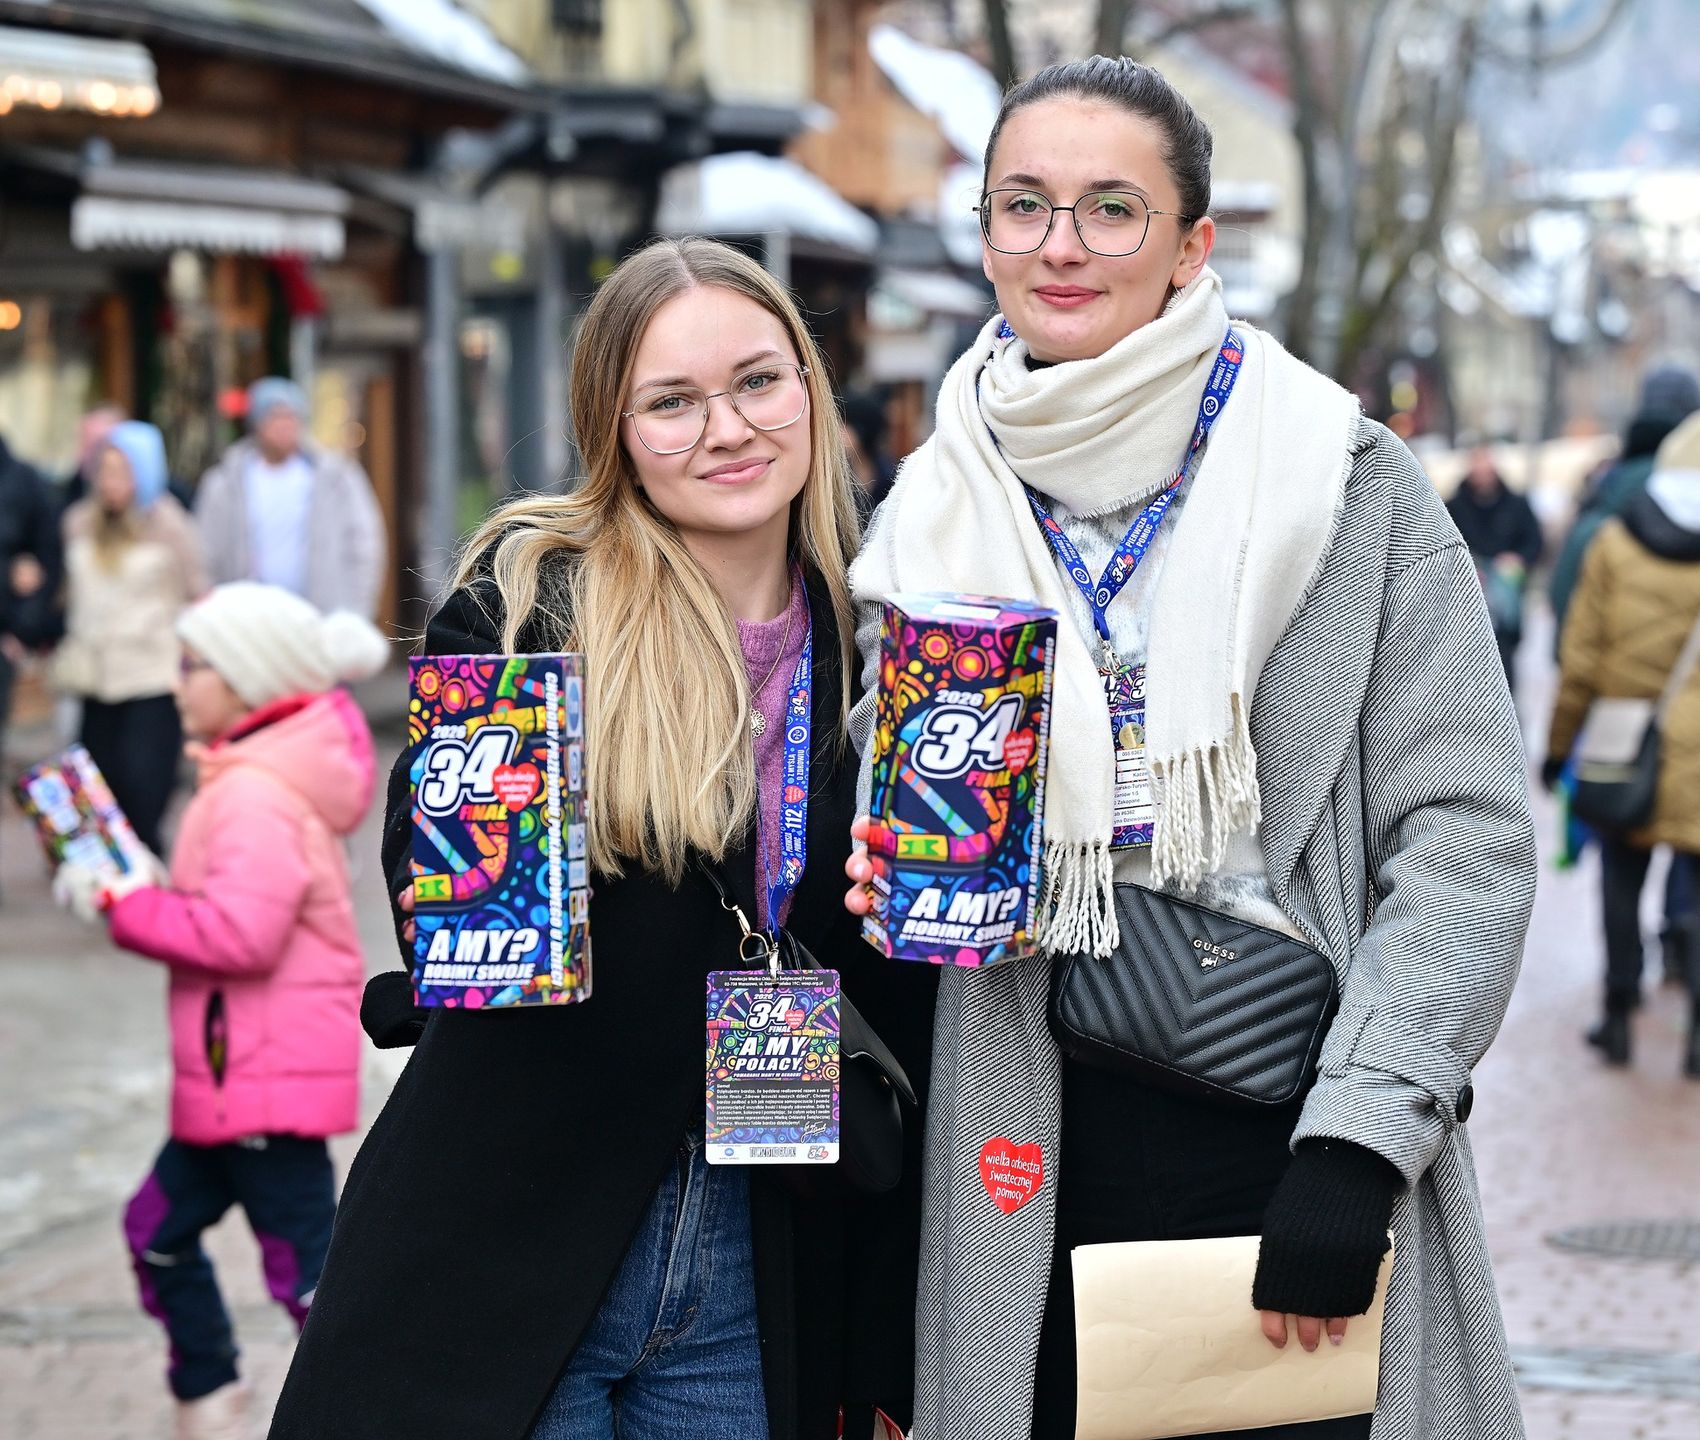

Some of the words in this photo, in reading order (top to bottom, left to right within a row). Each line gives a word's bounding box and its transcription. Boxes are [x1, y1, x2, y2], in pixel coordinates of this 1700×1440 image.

[1148, 494, 1171, 513] 112
[1125, 517, 1148, 548] PIERWSZA
[1136, 524, 1153, 548] POMOC
[1112, 554, 1129, 583] 34
[791, 696, 806, 716] 34
[934, 689, 985, 707] 2026
[431, 725, 467, 740] 2026
[914, 695, 1022, 776] 34
[420, 729, 515, 812] 34
[797, 750, 805, 776] ZDROWIU
[785, 808, 803, 829] 112
[785, 858, 798, 885] 34
[907, 887, 943, 920] A
[945, 887, 1022, 925] MY?
[902, 919, 977, 938] ROBIMY
[974, 921, 1017, 942] SWOJE
[426, 928, 451, 962] A
[453, 928, 540, 963] MY?
[1193, 939, 1235, 960] GUESS
[423, 964, 477, 980] ROBIMY
[476, 963, 536, 981] SWOJE
[747, 995, 795, 1031] 34
[739, 1037, 759, 1056] A
[764, 1037, 807, 1057] MY,
[734, 1058, 803, 1072] POLACY,
[986, 1151, 1010, 1167] wielka
[1011, 1155, 1040, 1174] orkiestra
[989, 1166, 1033, 1194] świątecznej
[995, 1186, 1024, 1205] pomocy
